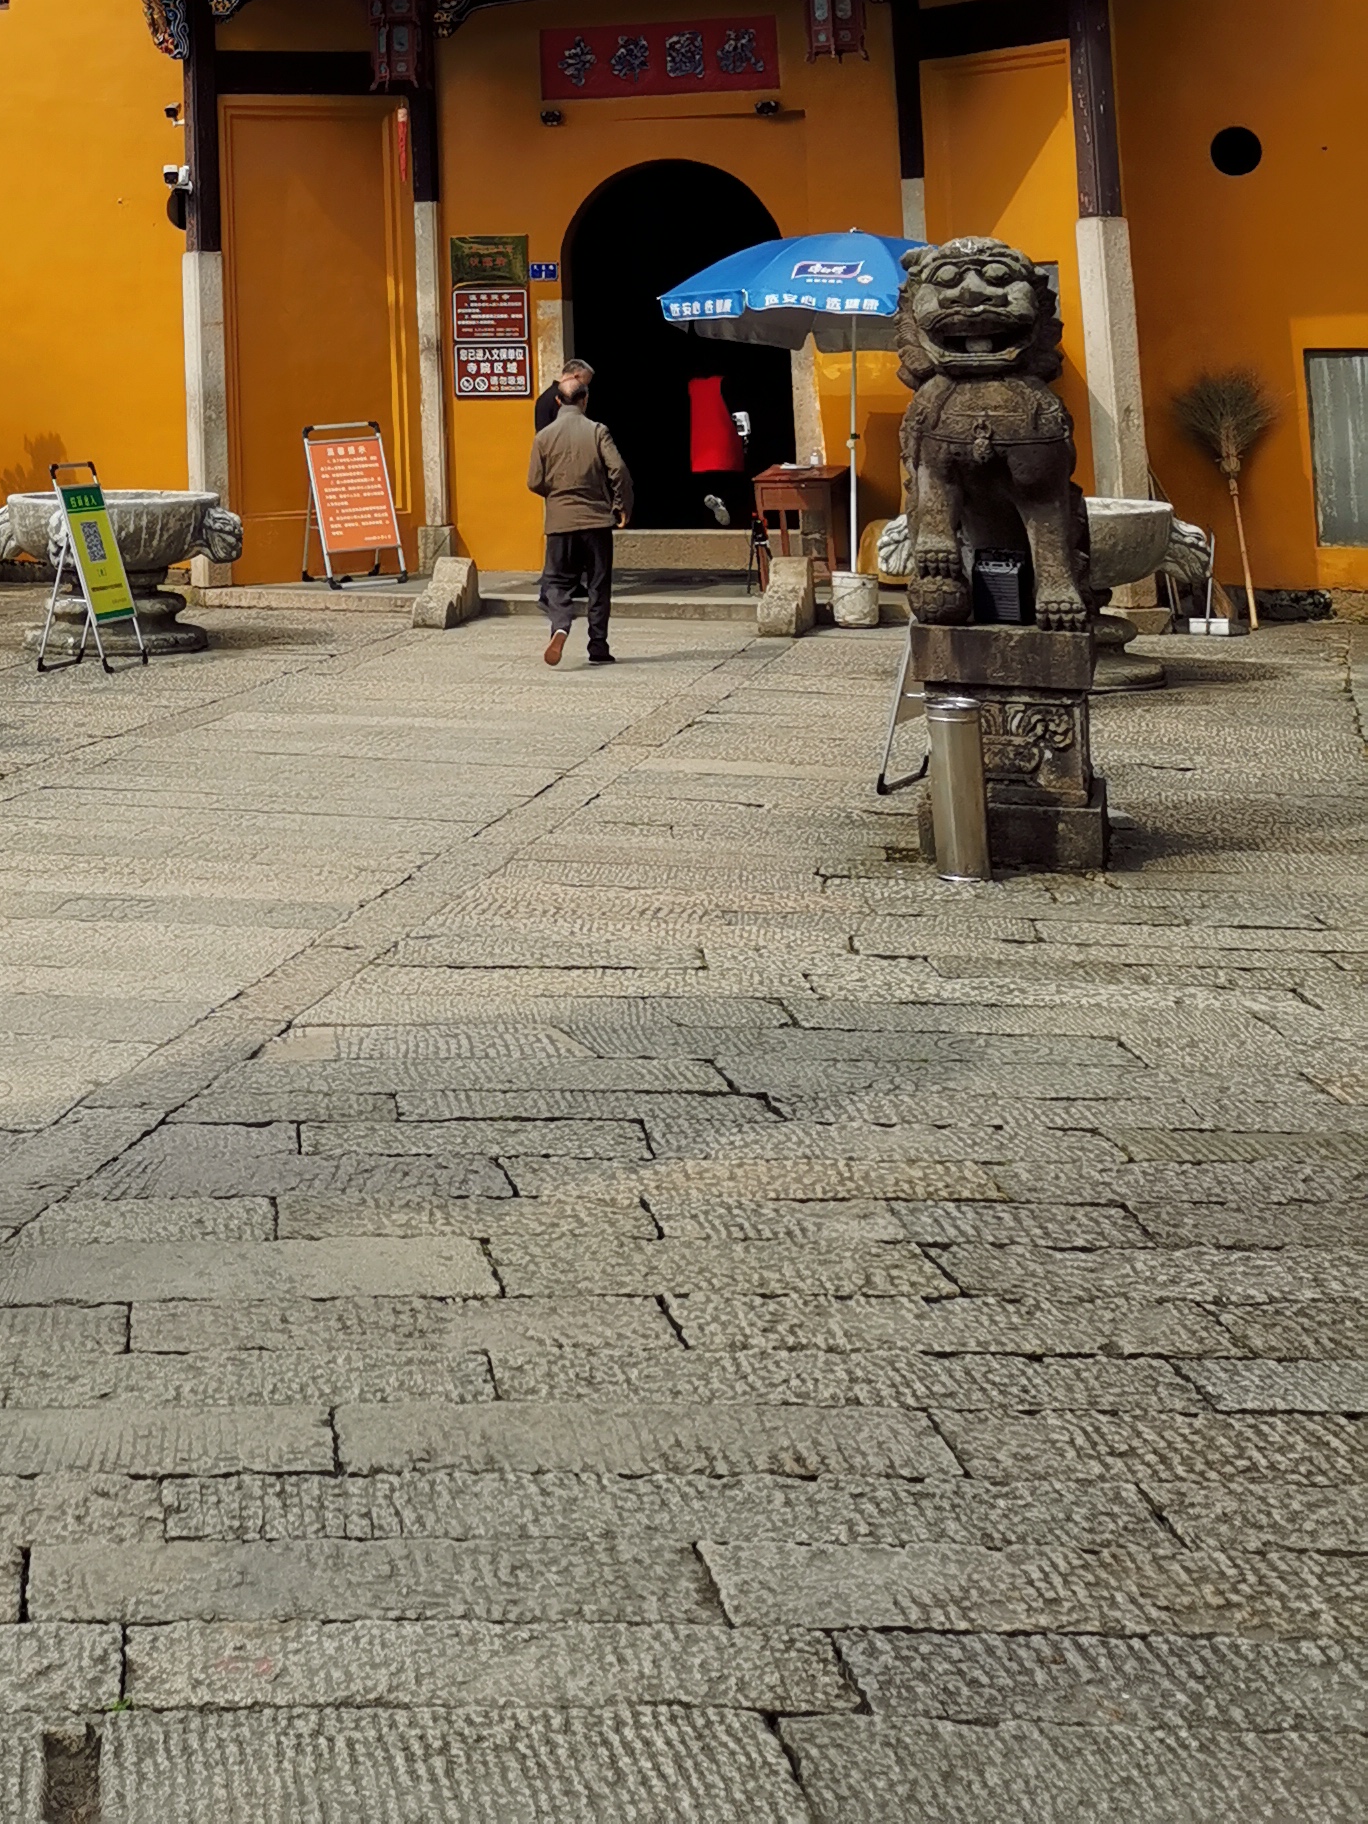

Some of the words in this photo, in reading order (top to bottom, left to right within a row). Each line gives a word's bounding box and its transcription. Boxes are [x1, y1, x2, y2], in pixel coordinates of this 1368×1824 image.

[460, 348, 524, 361] 您已进入文保单位
[467, 362, 517, 374] 寺院区域
